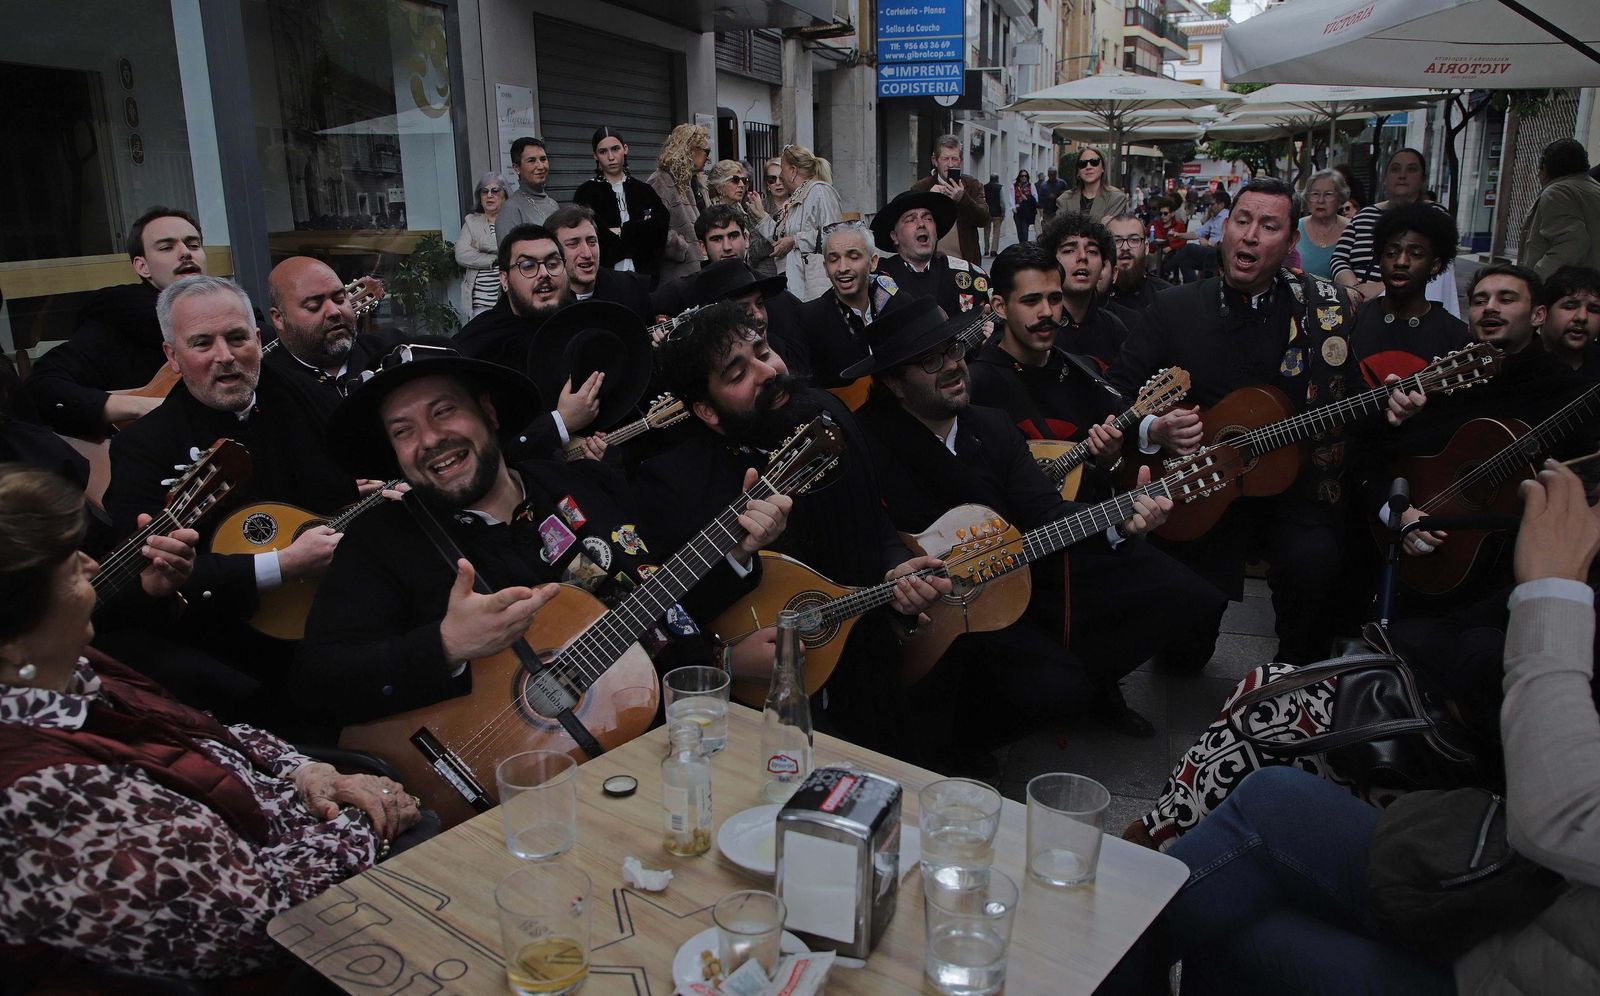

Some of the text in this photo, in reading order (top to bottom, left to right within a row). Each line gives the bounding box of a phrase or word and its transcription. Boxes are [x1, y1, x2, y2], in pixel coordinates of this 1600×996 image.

[923, 6, 946, 14] Planos
[1323, 6, 1374, 34] VICTORIA
[885, 25, 905, 34] Sellos
[915, 24, 940, 33] Caucho
[904, 42, 918, 50] 956
[930, 41, 940, 49] 36
[941, 40, 951, 48] 69
[896, 64, 960, 77] IMPRENTA
[881, 81, 959, 94] COPISTERIA
